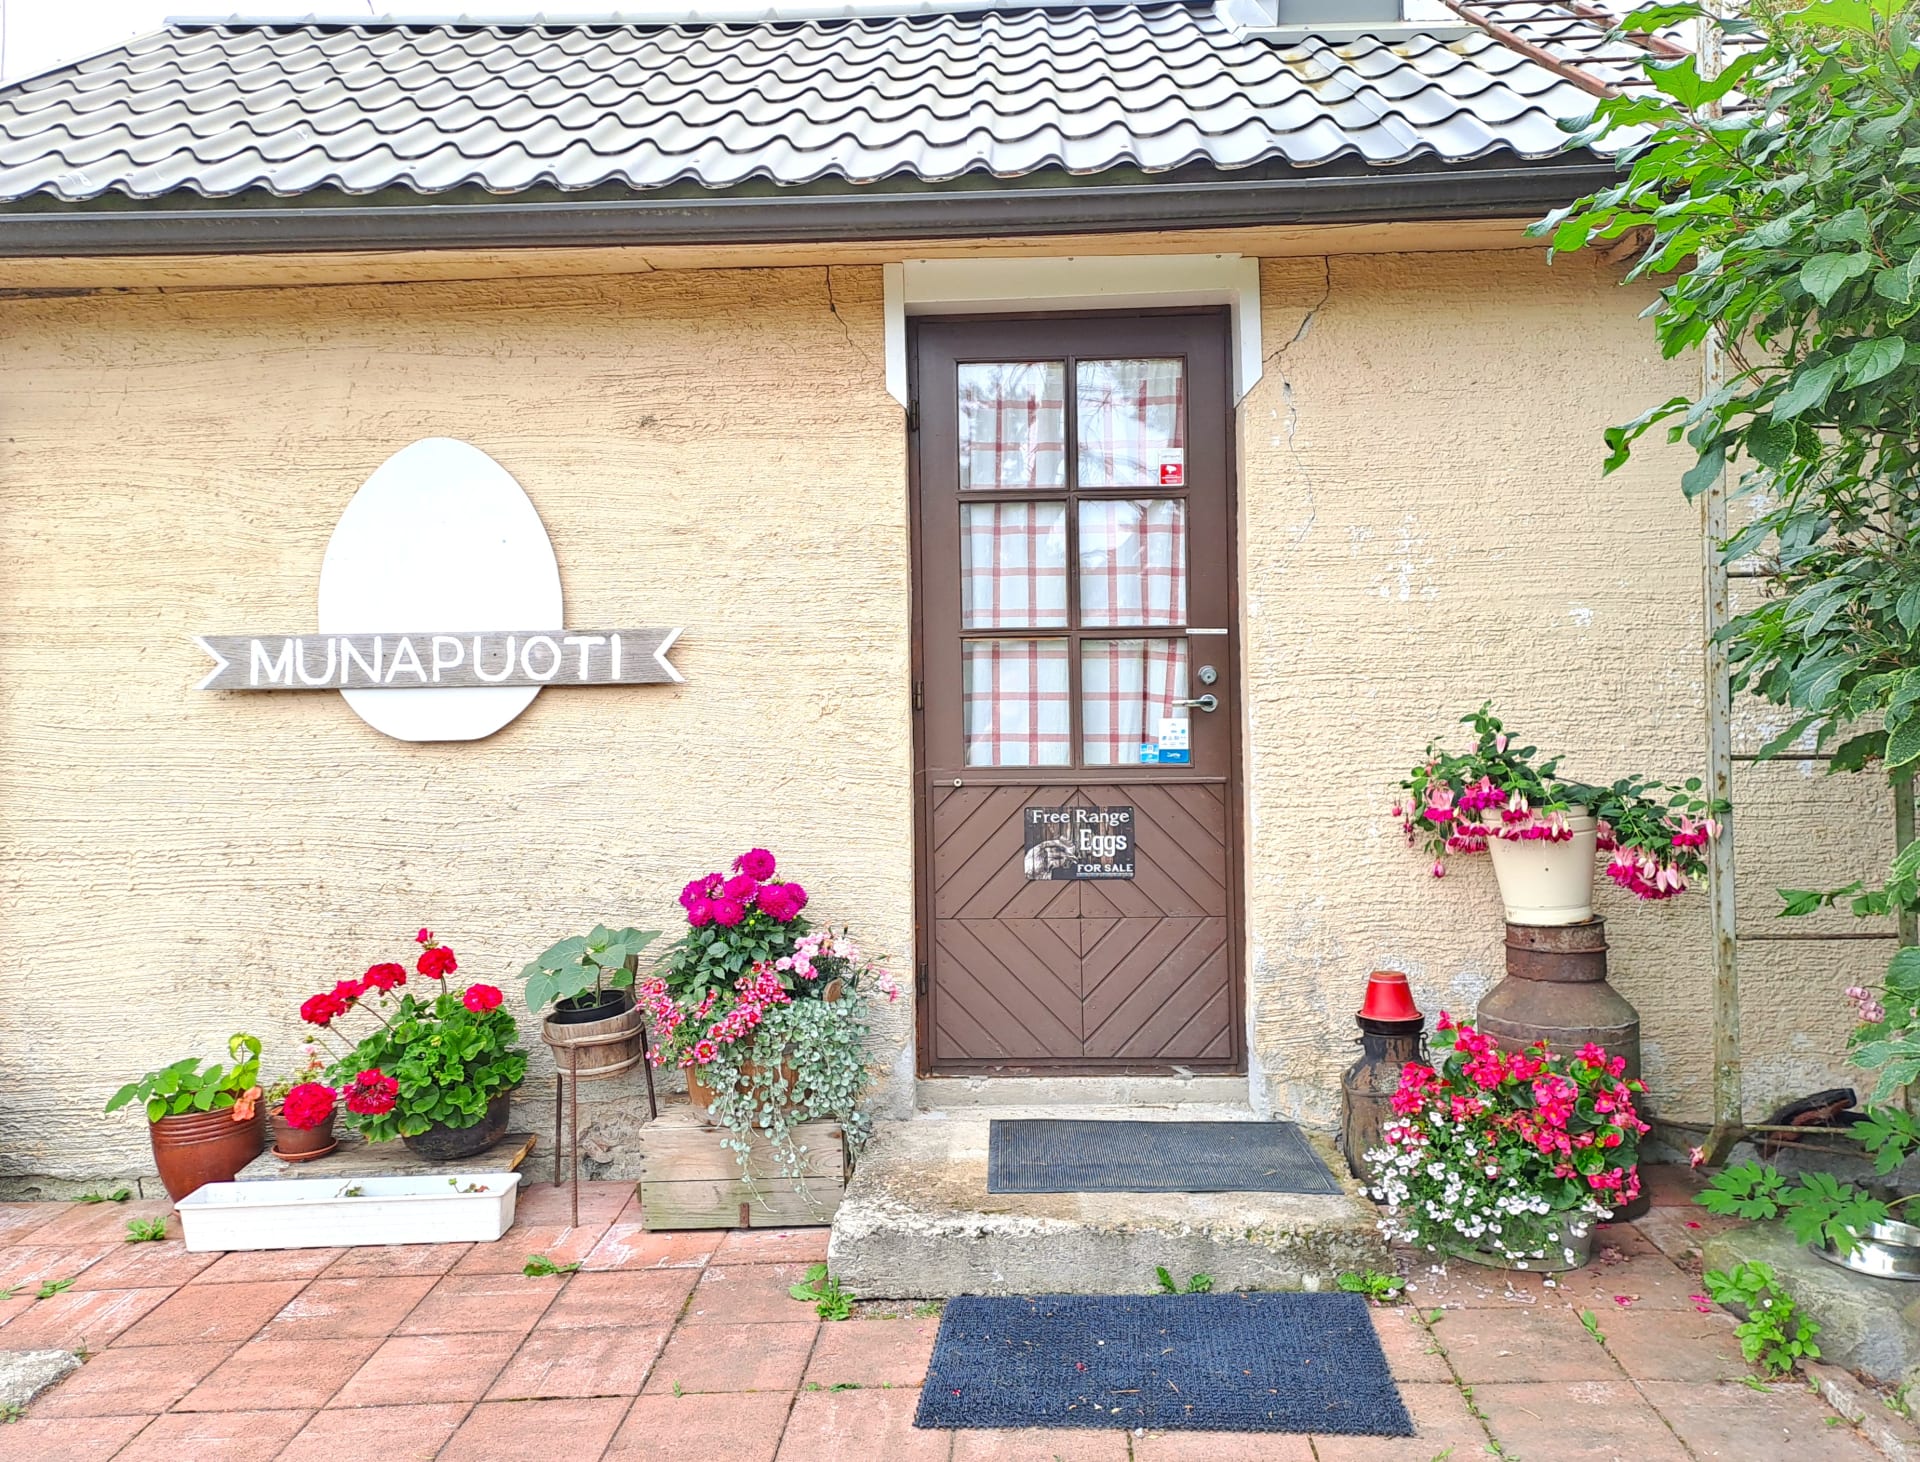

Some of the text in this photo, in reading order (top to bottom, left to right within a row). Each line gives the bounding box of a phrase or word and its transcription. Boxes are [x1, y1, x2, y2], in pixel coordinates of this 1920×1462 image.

[249, 634, 622, 685] MUNAPUOTI
[1032, 809, 1130, 827] Free Range
[1080, 829, 1127, 858] Eggs
[1077, 864, 1134, 873] FOR SALE
